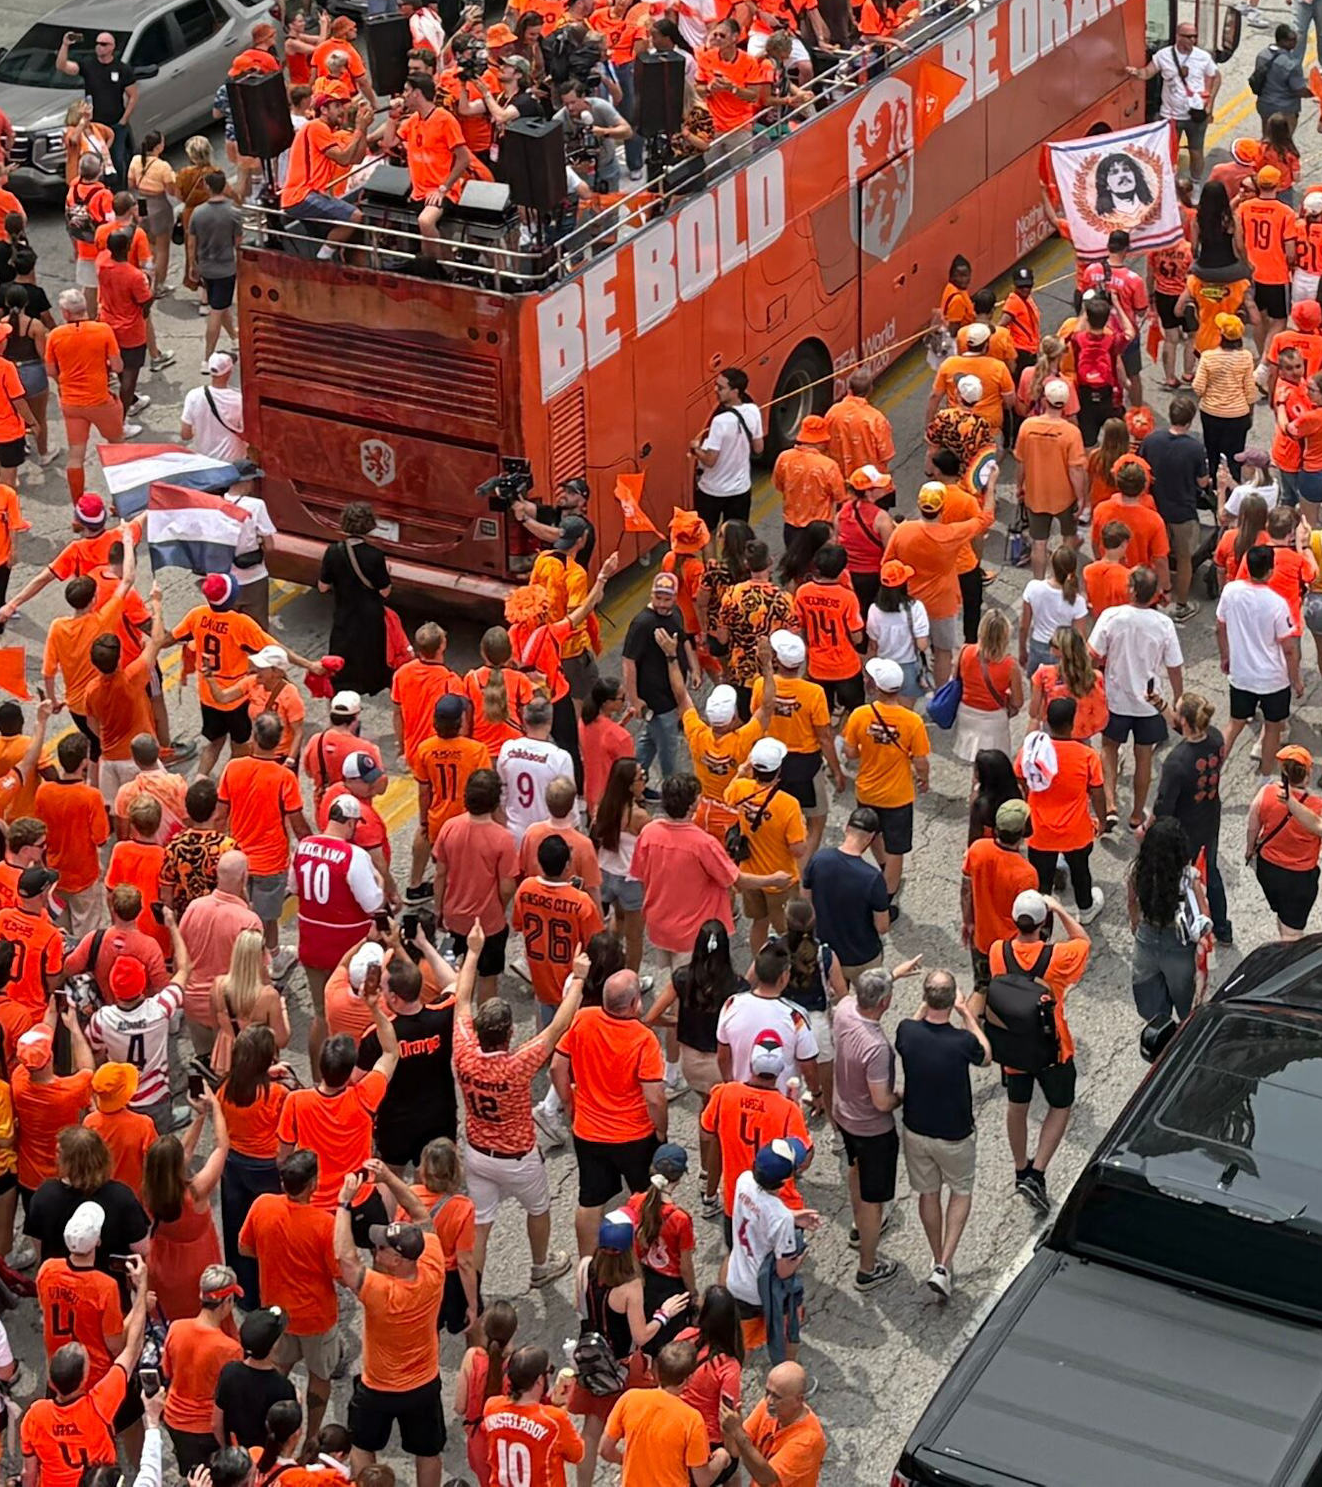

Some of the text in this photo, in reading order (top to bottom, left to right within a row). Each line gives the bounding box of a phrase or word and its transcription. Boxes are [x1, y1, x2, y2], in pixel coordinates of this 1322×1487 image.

[942, 5, 1000, 124] BE
[1251, 217, 1271, 250] 19
[536, 149, 785, 405] BE BOLD
[861, 316, 897, 361] World
[808, 609, 838, 648] 14
[434, 762, 458, 802] 11
[516, 771, 535, 809] 9
[299, 859, 331, 905] 10
[554, 895, 583, 915] CITY
[523, 912, 572, 965] 26
[467, 1091, 503, 1124] 12
[738, 1111, 761, 1161] 4
[51, 1303, 80, 1343] 4
[496, 1437, 532, 1487] 10
